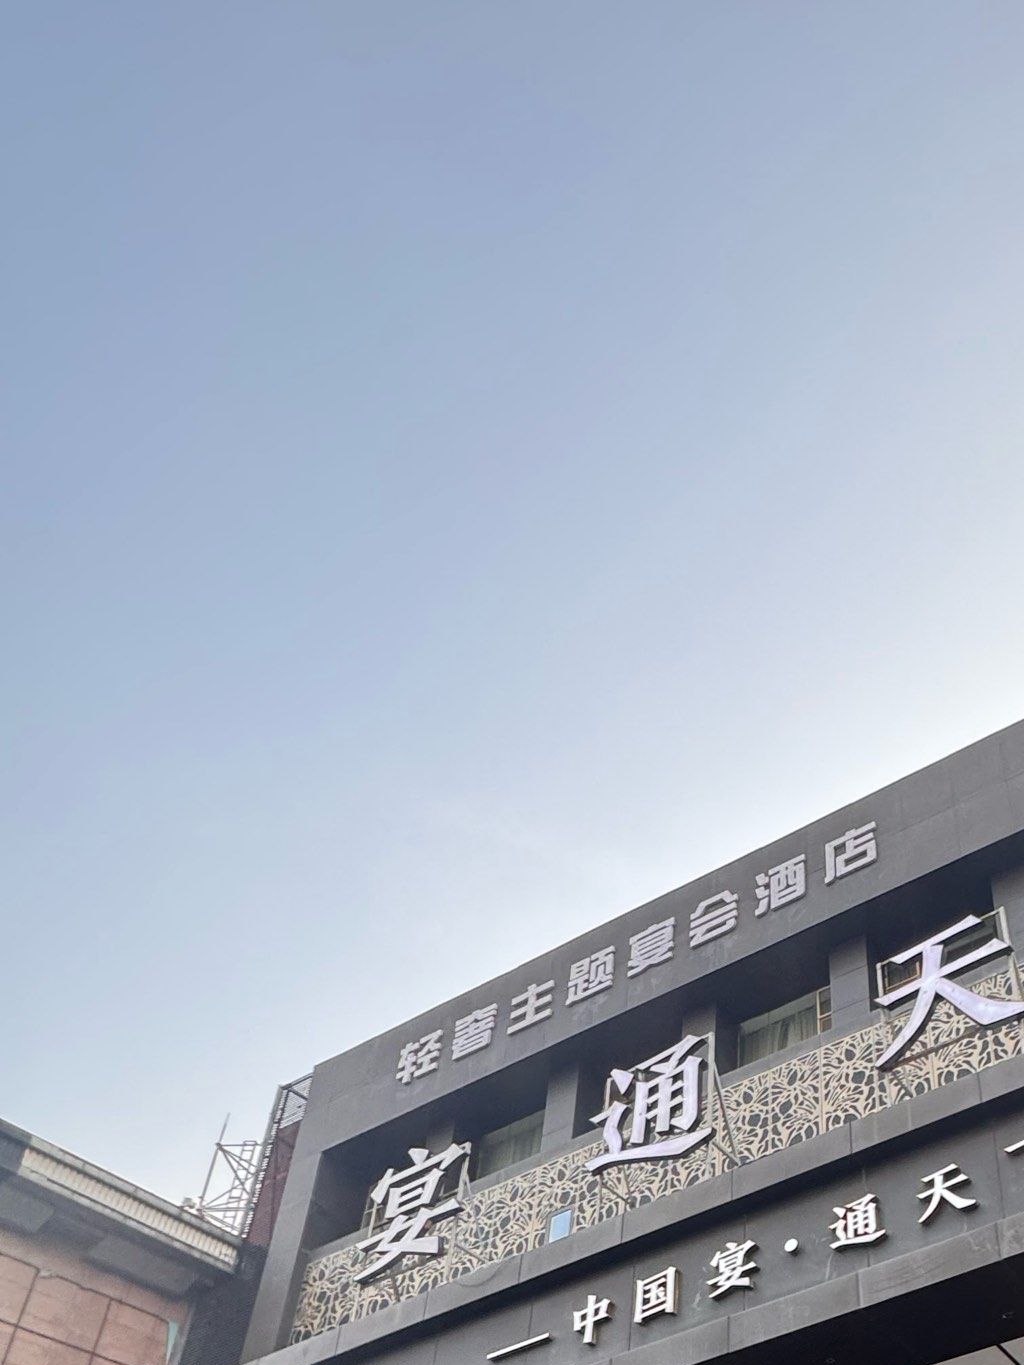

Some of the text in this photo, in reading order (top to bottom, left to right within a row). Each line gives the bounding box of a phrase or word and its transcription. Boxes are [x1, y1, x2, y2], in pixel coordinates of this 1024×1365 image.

[395, 821, 878, 1085] 轻奢主题宴会酒店
